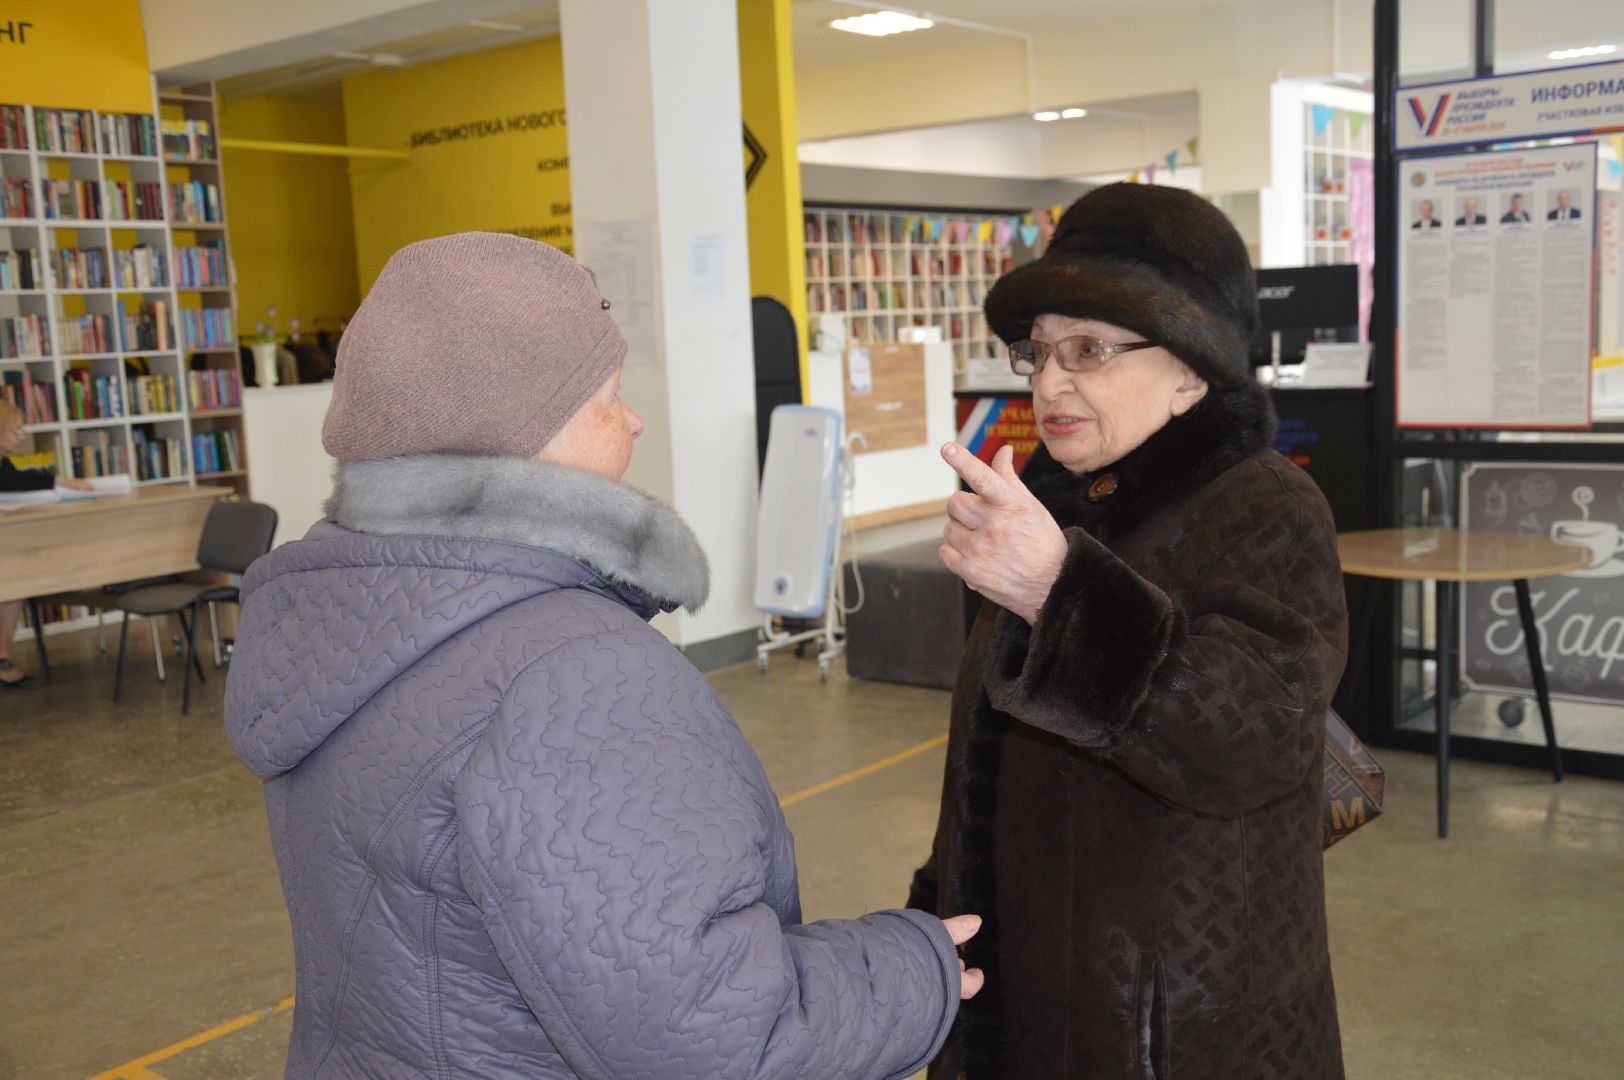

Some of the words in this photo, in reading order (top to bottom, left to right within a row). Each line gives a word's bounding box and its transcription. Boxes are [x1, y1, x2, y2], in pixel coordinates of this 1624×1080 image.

[1531, 79, 1624, 104] ИНФОРМА
[410, 118, 504, 148] БИБЛИОТЕКА
[1257, 286, 1294, 299] acer
